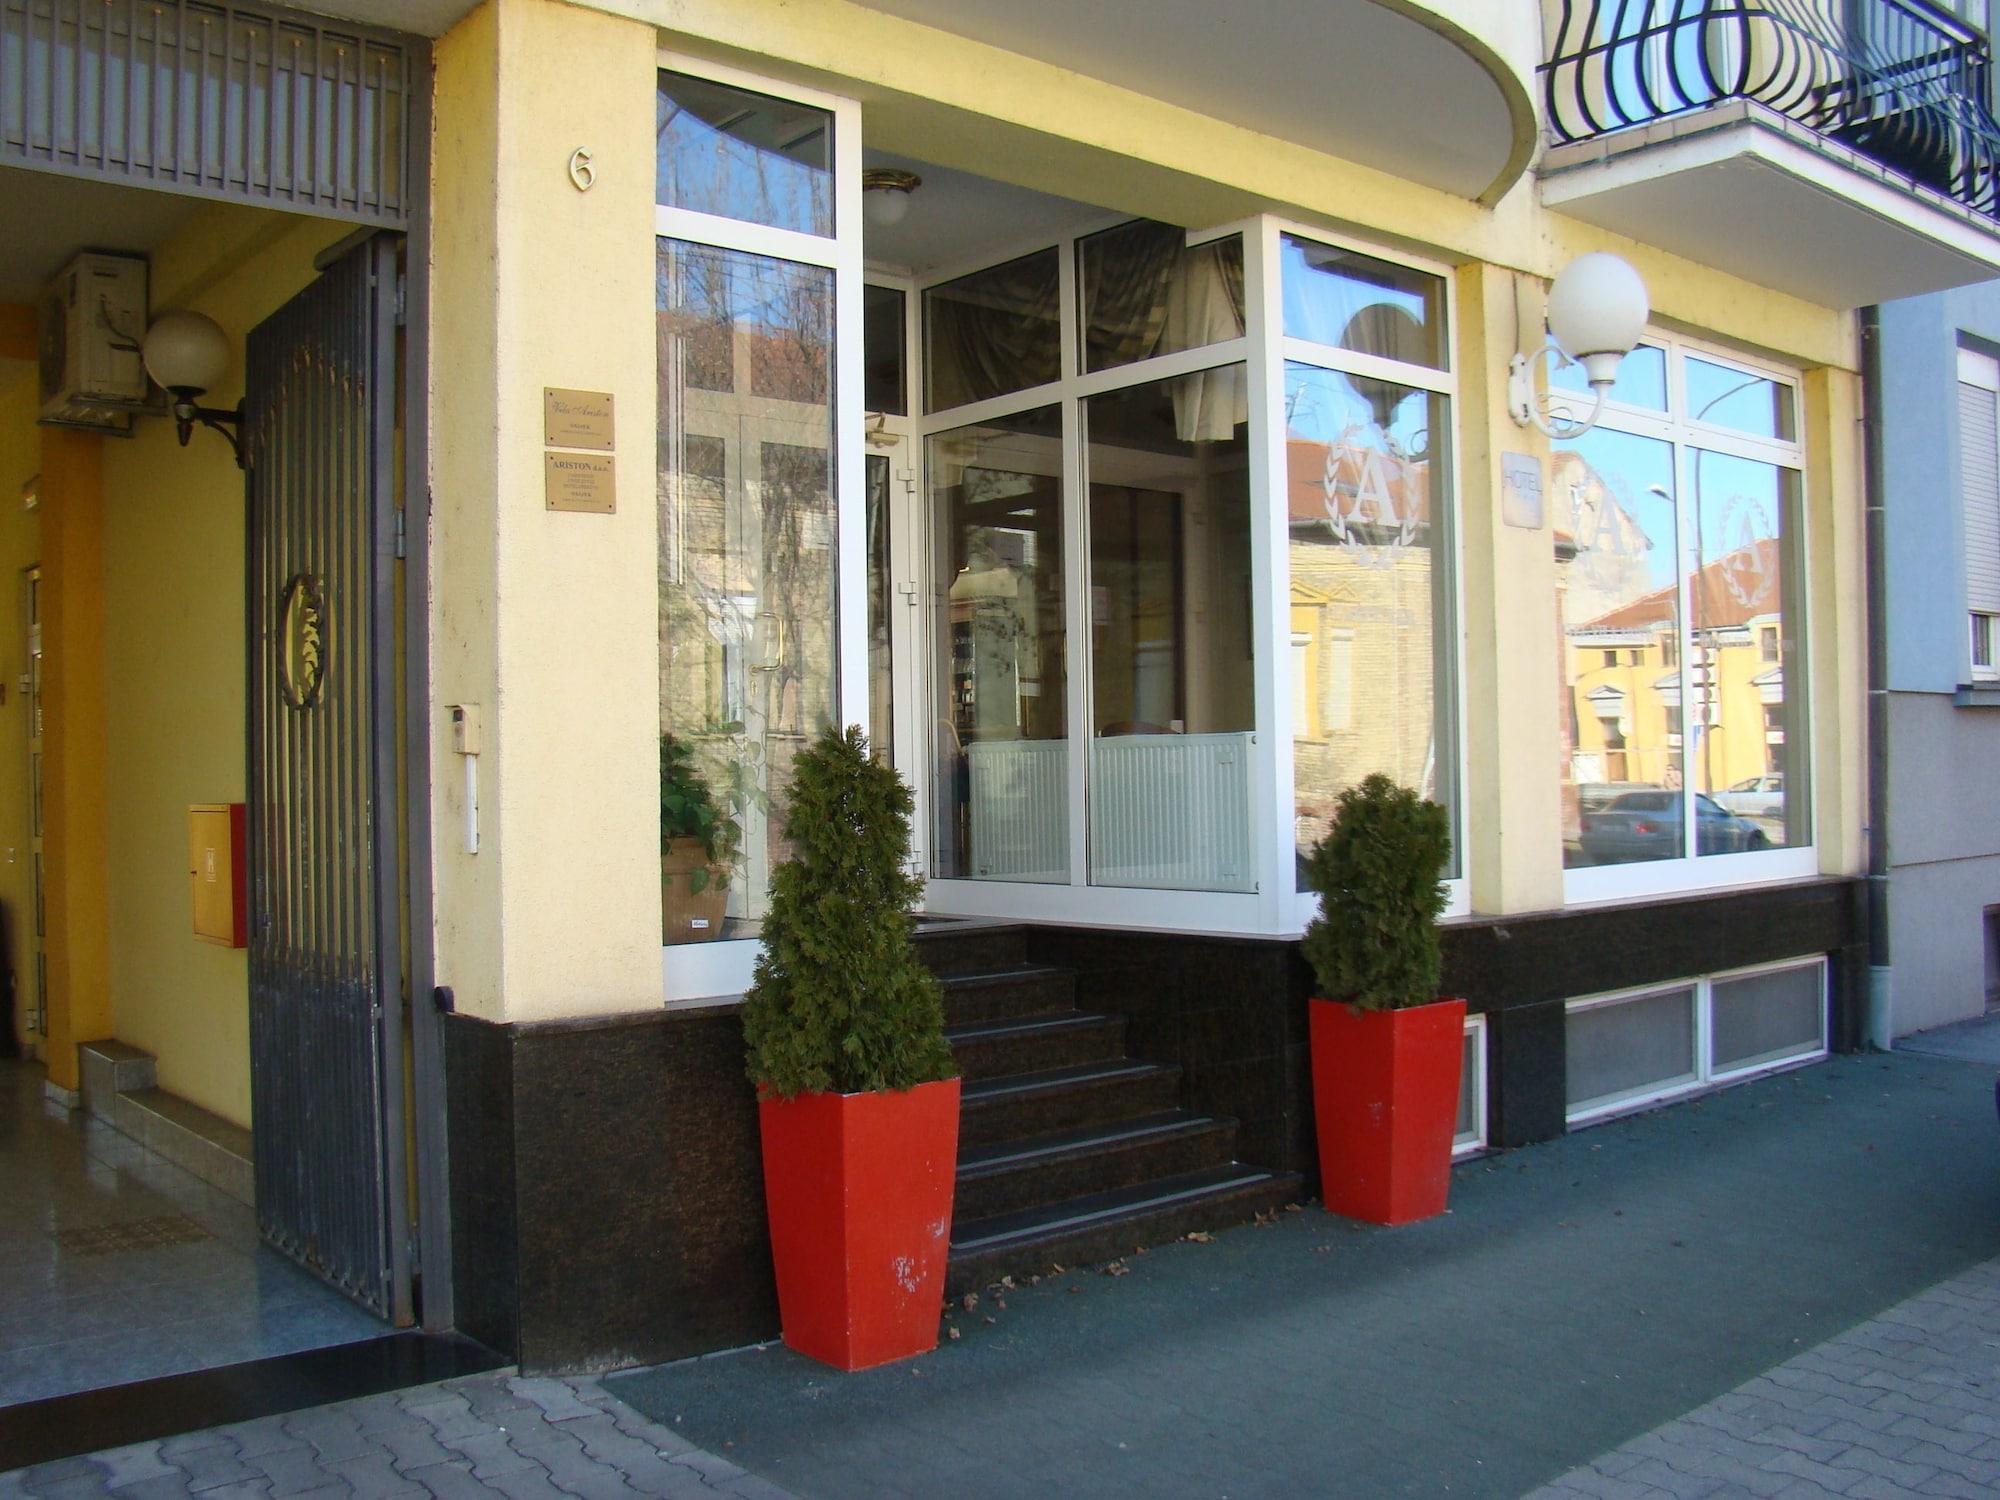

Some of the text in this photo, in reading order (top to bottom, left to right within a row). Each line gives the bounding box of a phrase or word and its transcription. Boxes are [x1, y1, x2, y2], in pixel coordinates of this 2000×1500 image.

[570, 146, 597, 191] 6
[553, 460, 592, 472] ARISTON
[1502, 469, 1544, 495] HOTEL
[1345, 448, 1401, 527] A
